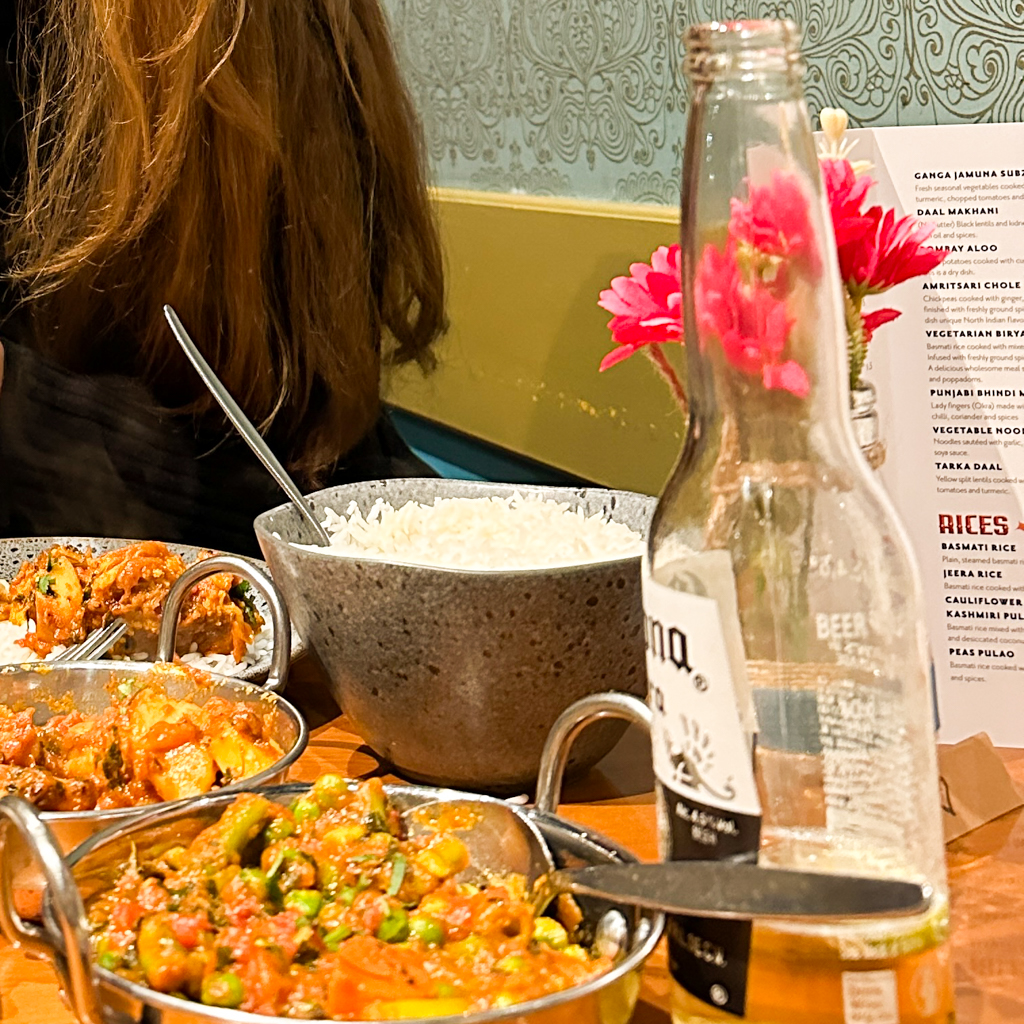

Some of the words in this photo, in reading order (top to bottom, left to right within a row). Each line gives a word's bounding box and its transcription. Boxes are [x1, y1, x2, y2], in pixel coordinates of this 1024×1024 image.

[914, 172, 952, 180] GANGA
[954, 170, 997, 181] JAMUNA
[915, 184, 932, 192] Fresh
[963, 183, 999, 193] vegetables
[947, 195, 977, 204] chopped
[948, 207, 999, 216] MAKHANI
[956, 220, 974, 228] Black
[967, 244, 998, 252] ALOO
[942, 258, 972, 266] potatoes
[948, 269, 959, 277] dry
[922, 282, 981, 290] AMRITSARI
[958, 294, 984, 302] cooked
[923, 305, 949, 313] finished
[966, 305, 988, 314] freshly
[989, 305, 1013, 314] ground
[939, 317, 962, 325] unique
[967, 353, 989, 362] freshly
[989, 354, 1013, 363] ground
[934, 364, 963, 372] delicious
[930, 389, 974, 398] PUNJABI
[977, 389, 1016, 397] BHINDI
[931, 402, 947, 410] Lady
[948, 402, 971, 411] fingers
[971, 402, 995, 410] (Okra)
[998, 414, 1019, 422] spices
[932, 426, 993, 434] VEGETABLE
[935, 462, 971, 470] TARKA
[974, 463, 1003, 471] DAAL
[958, 475, 972, 484] split
[993, 476, 1017, 484] cooked
[938, 513, 1009, 536] RICES
[941, 542, 988, 551] BASMATI
[991, 544, 1017, 552] RICE
[961, 556, 991, 564] steamed
[992, 557, 1018, 565] basmati
[943, 569, 975, 579] JEERA
[977, 570, 1002, 579] RICE
[944, 582, 970, 590] Basmati
[985, 584, 1011, 592] cooked
[945, 596, 1023, 606] CAULIFLOWER
[946, 610, 1001, 619] KASHMIRI
[947, 623, 973, 631] Basmati
[974, 624, 988, 632] rice
[988, 625, 1010, 633] mixed
[961, 636, 998, 644] desiccated
[949, 648, 975, 656] PEAS
[978, 649, 1015, 658] PULAO
[949, 661, 976, 669] Basmati
